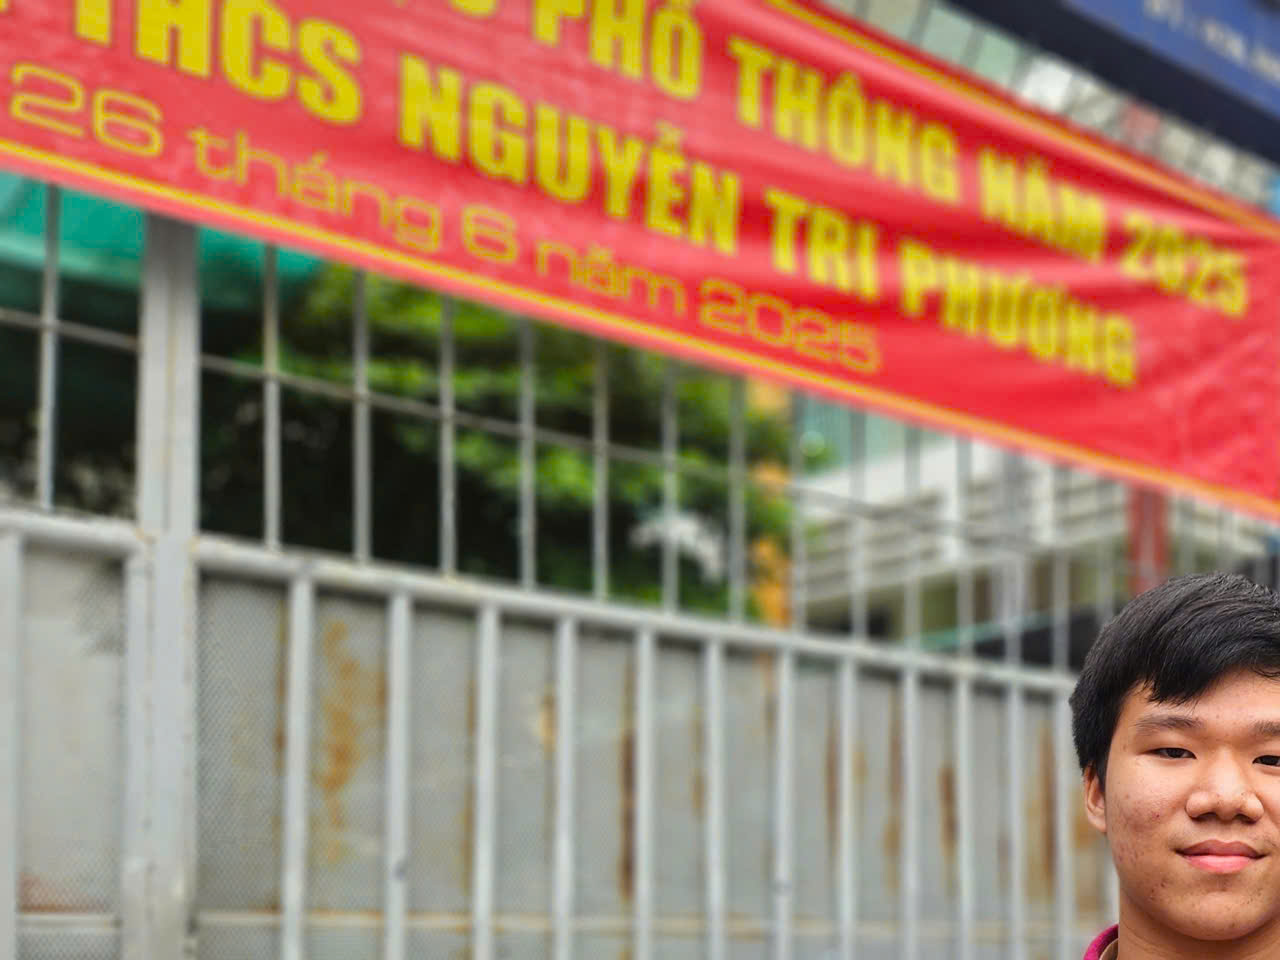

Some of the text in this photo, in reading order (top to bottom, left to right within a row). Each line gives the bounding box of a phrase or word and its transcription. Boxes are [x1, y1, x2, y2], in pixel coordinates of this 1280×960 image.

[9, 61, 881, 374] 26 tháng 6 năm 2025
[727, 35, 959, 202] THÔNG
[1118, 207, 1248, 318] 2025
[764, 185, 877, 302] TRI
